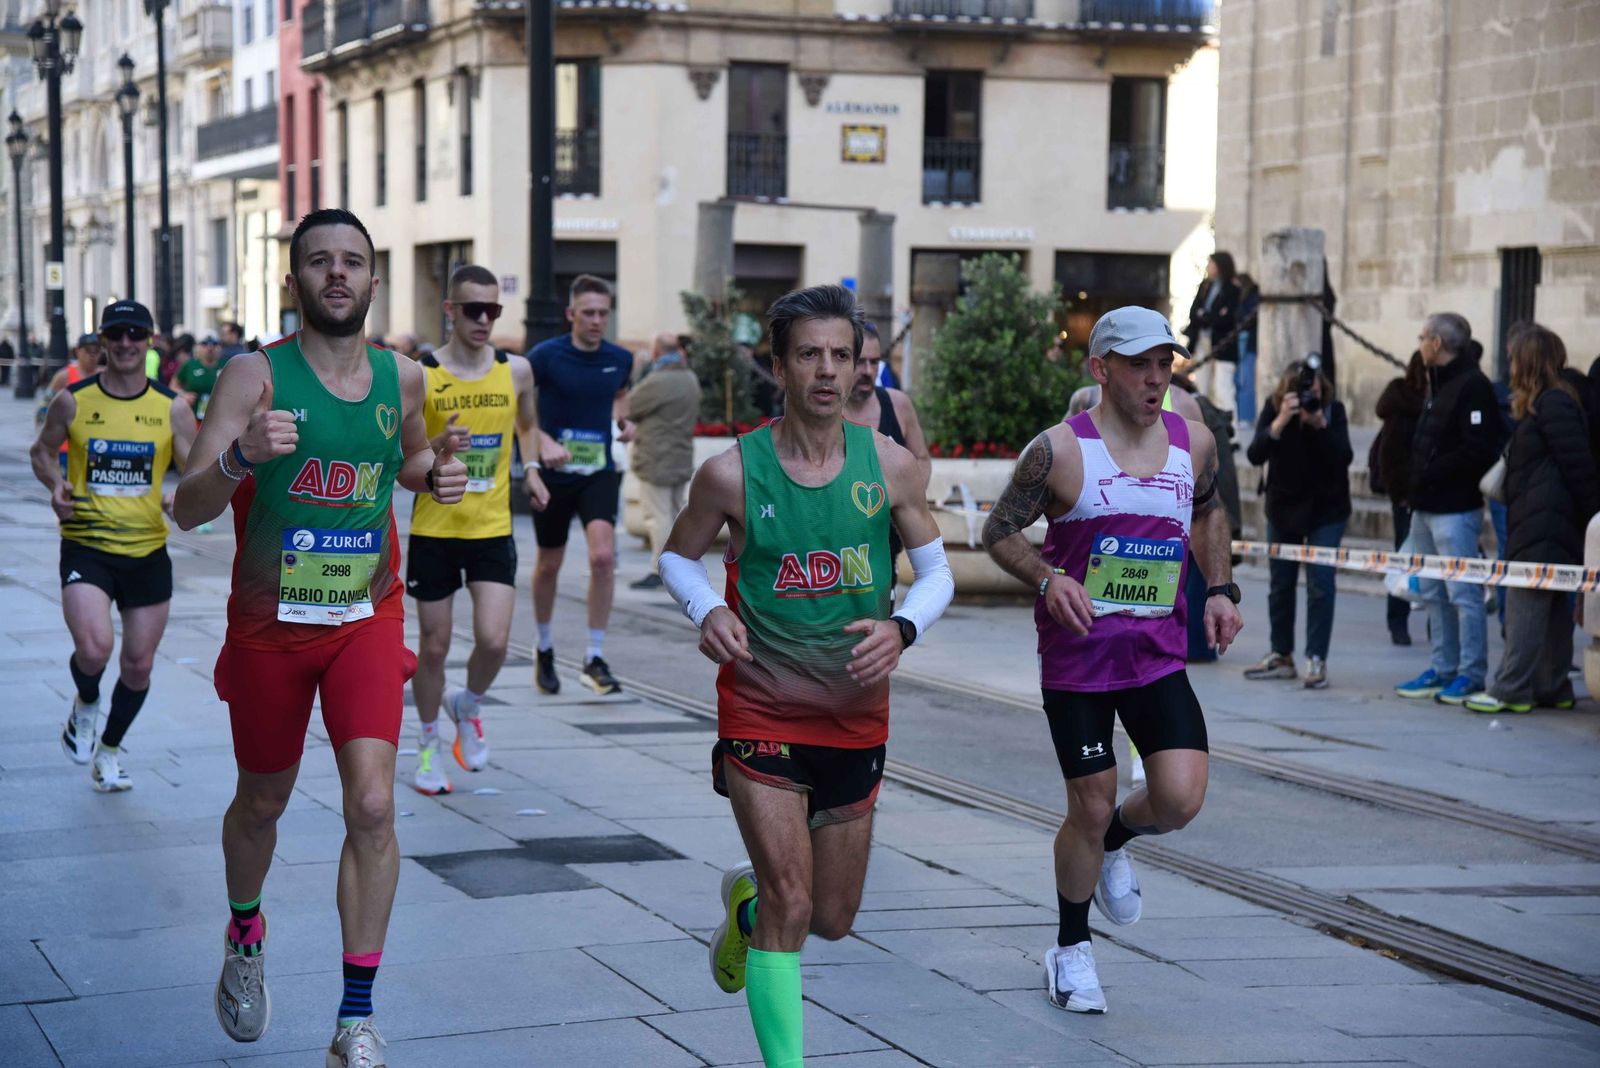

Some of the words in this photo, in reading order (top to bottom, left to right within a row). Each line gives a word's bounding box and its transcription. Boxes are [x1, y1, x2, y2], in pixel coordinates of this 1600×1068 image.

[433, 397, 457, 411] VILLA
[460, 395, 471, 408] DE
[473, 393, 510, 408] CABEZON
[111, 443, 148, 453] ZURICH
[91, 469, 147, 484] PASQUAL
[287, 457, 384, 501] ADN
[321, 534, 373, 549] ZURICH
[1124, 543, 1175, 556] ZURICH
[321, 563, 351, 577] 2998
[773, 543, 873, 591] ADN
[1121, 567, 1149, 580] 2849
[280, 586, 324, 603] FABIO
[1102, 582, 1158, 602] AIMAR
[756, 741, 790, 757] ADN
